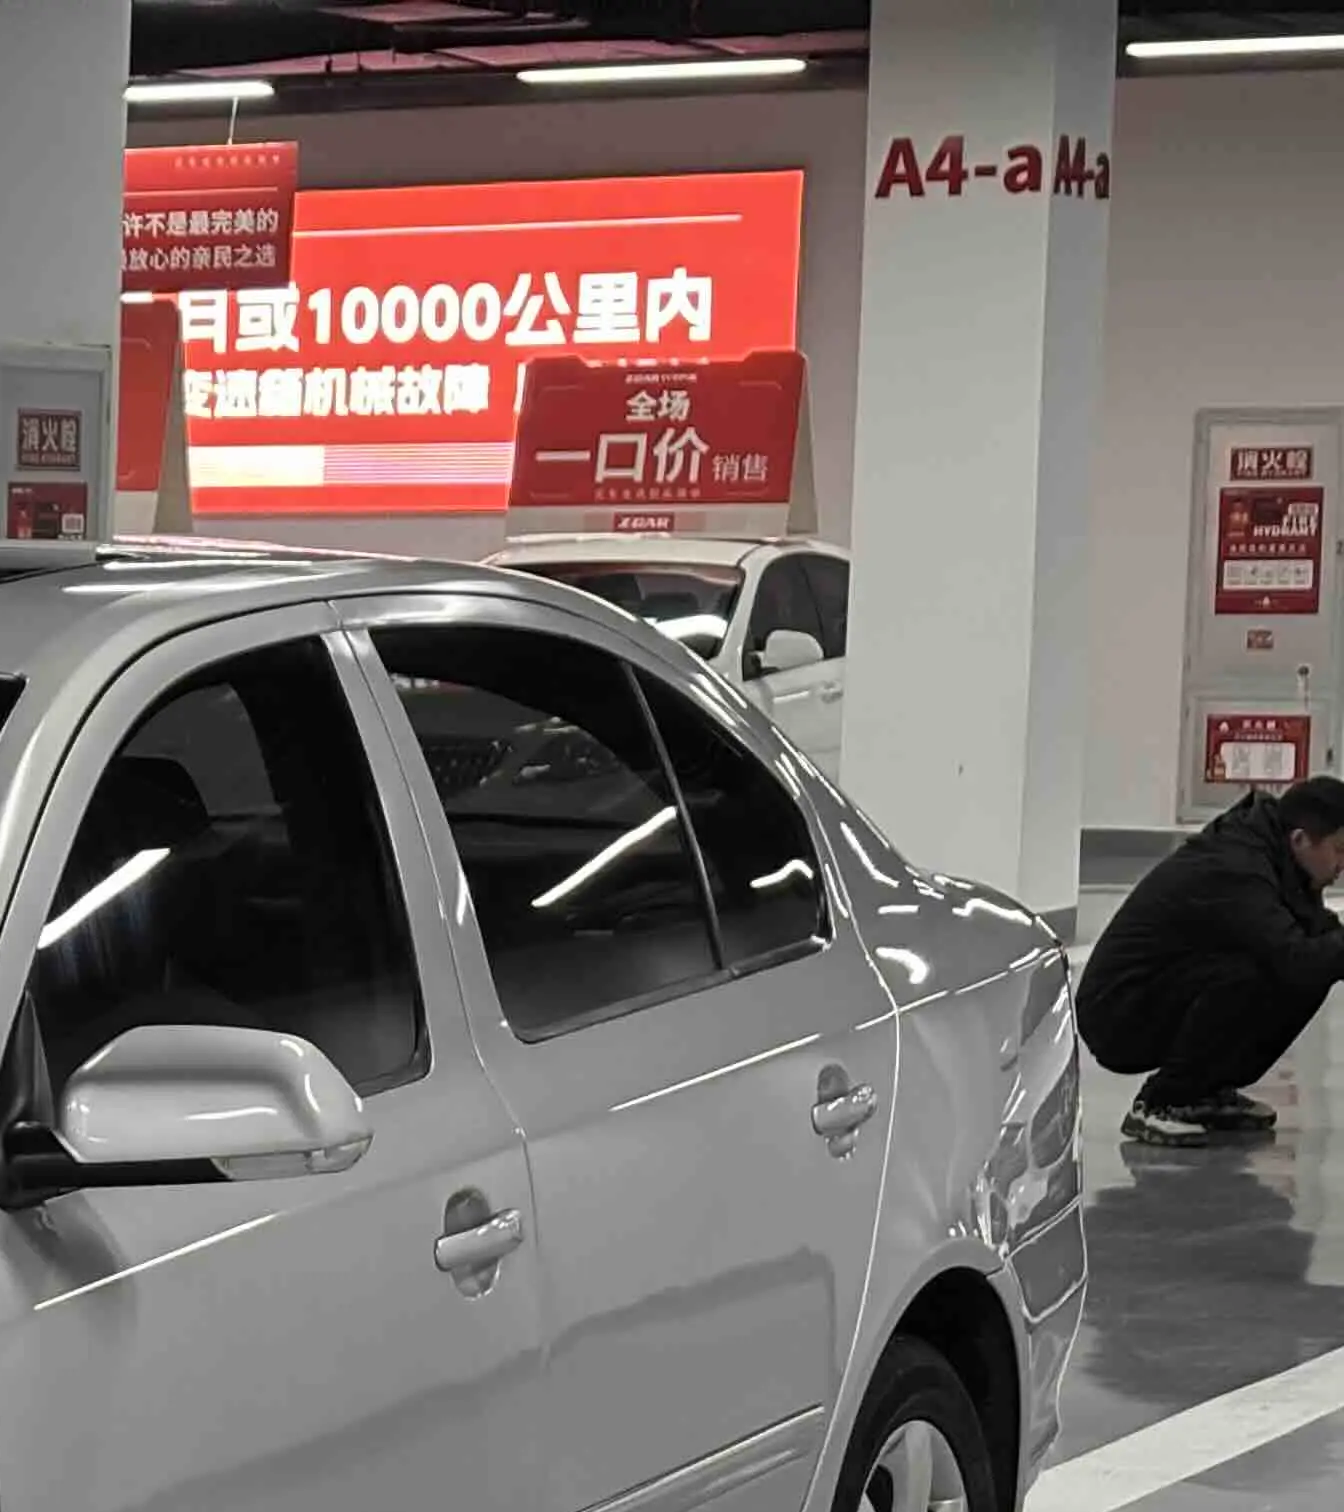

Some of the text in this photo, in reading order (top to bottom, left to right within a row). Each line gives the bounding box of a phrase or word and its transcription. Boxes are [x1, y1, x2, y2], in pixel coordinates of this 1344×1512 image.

[874, 135, 1043, 199] A4-a
[625, 389, 691, 422] 全场
[535, 426, 769, 484] 一口价 销售
